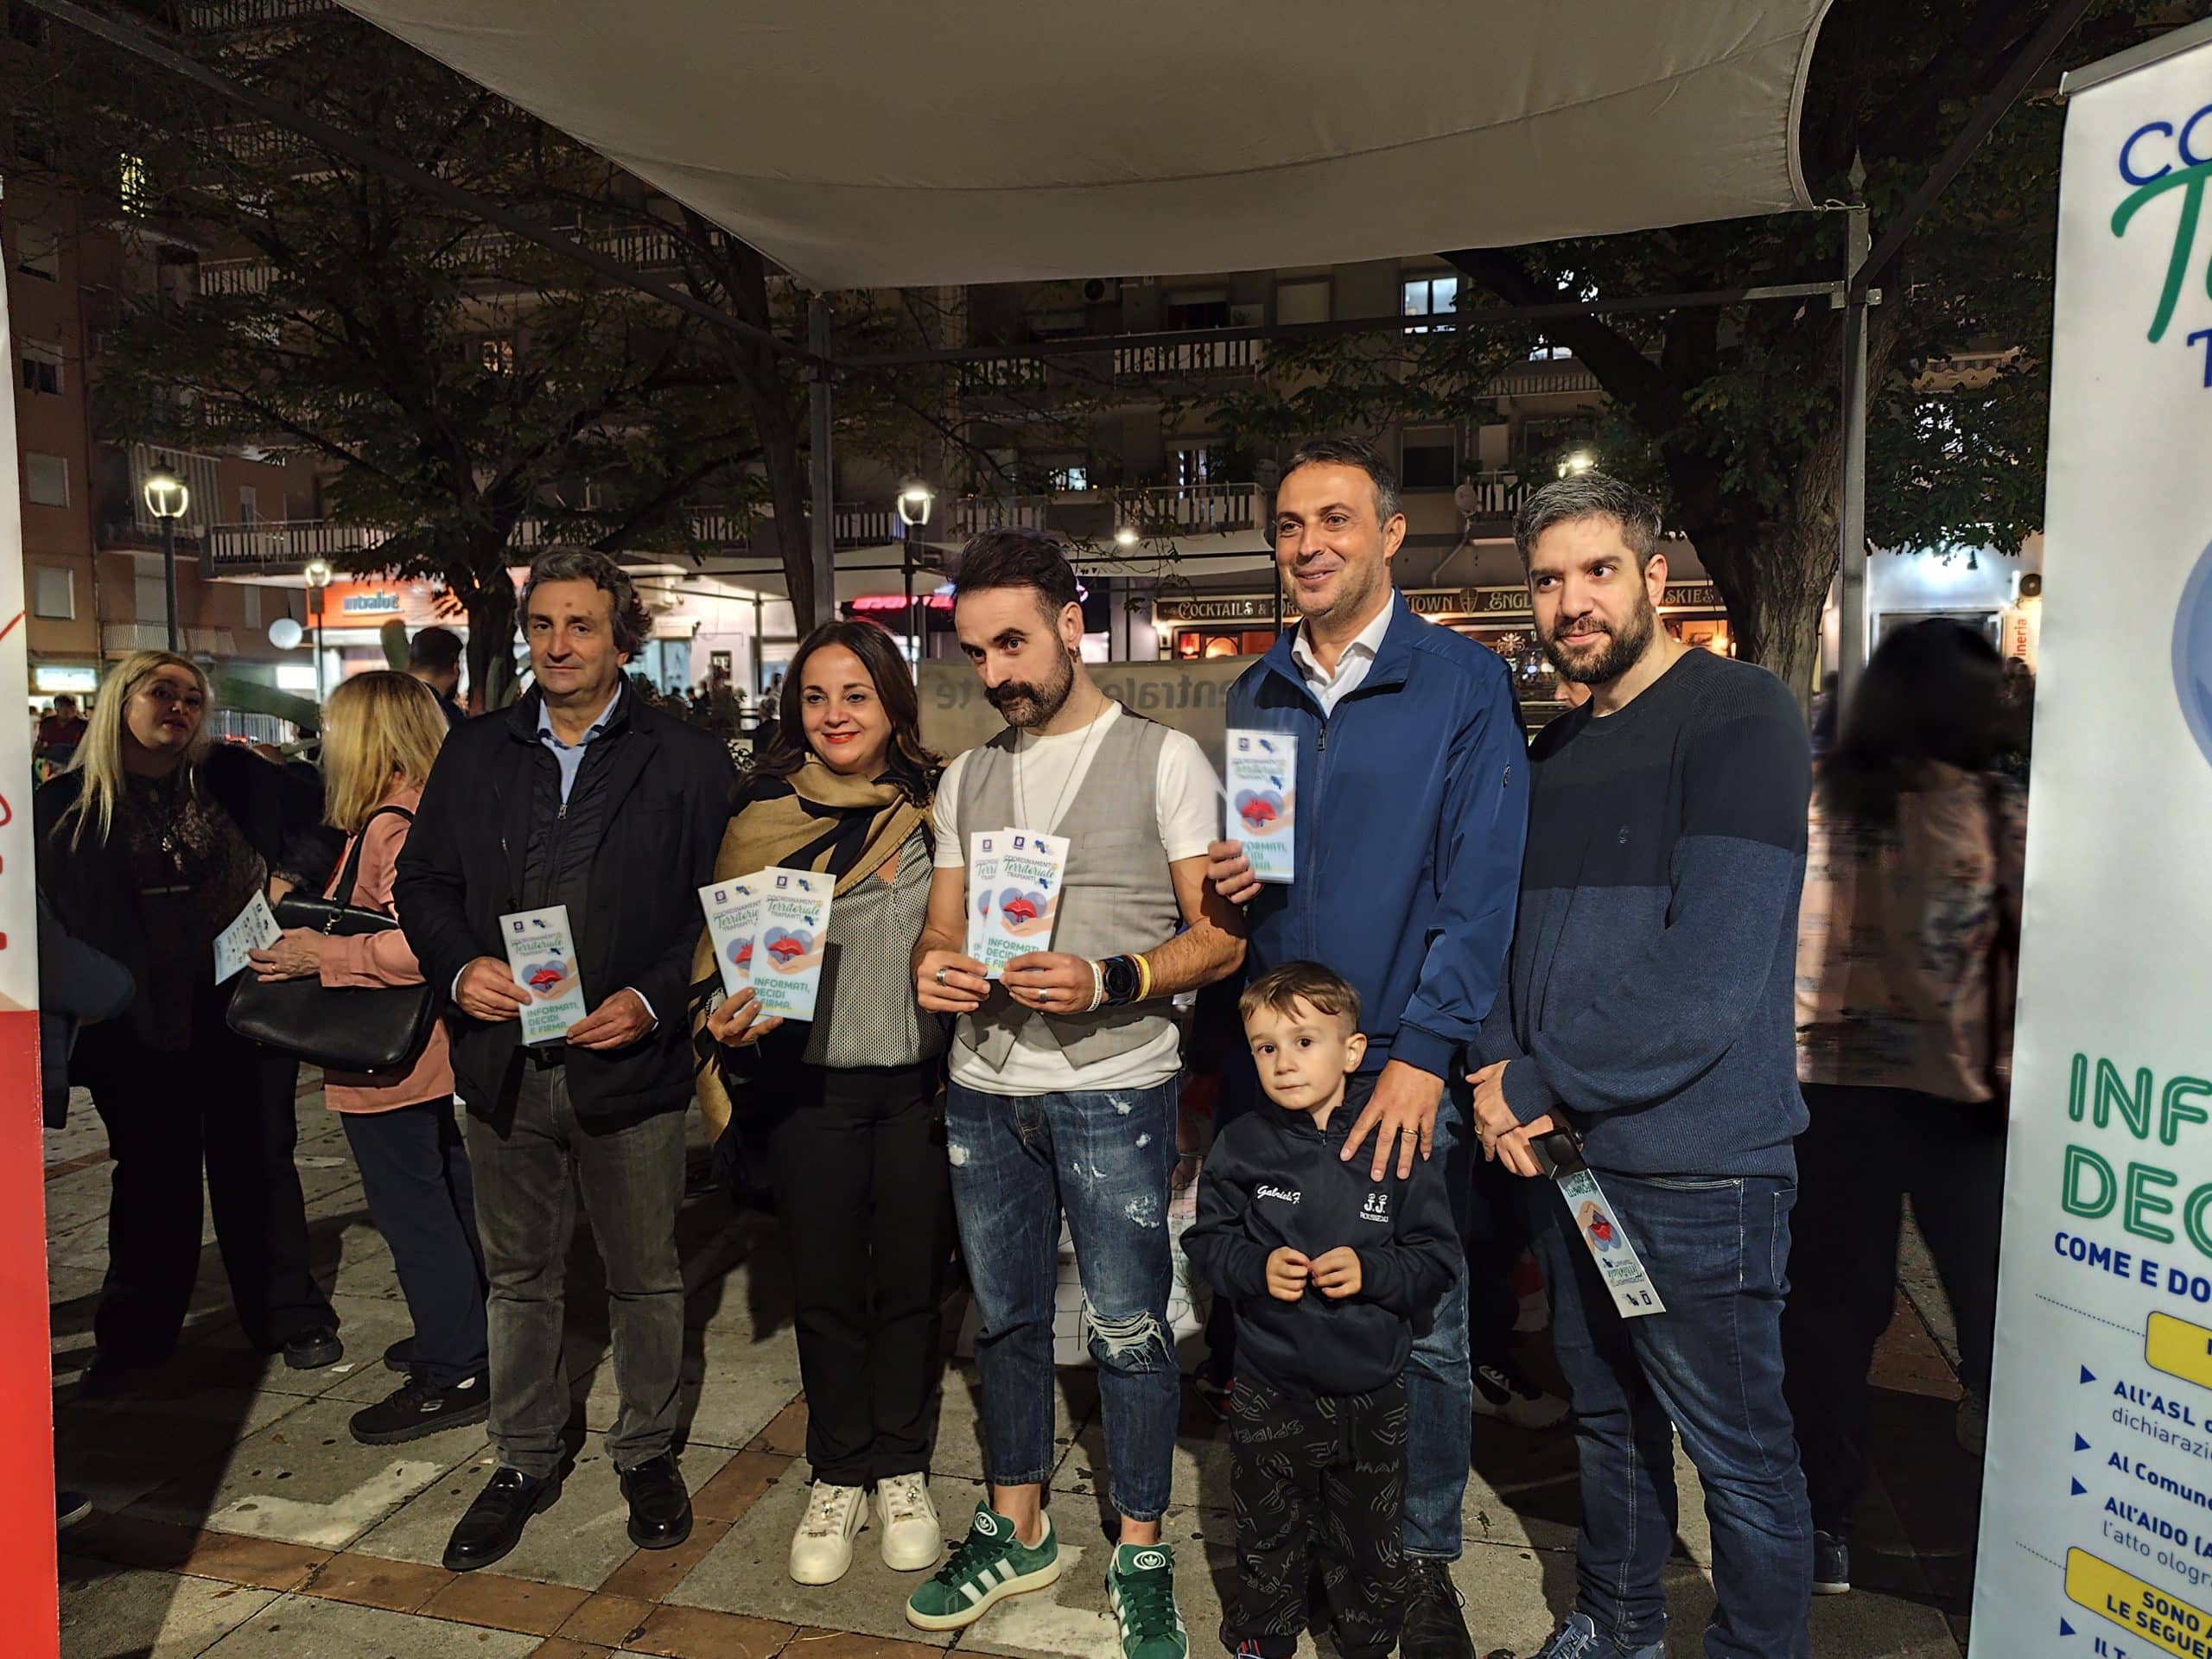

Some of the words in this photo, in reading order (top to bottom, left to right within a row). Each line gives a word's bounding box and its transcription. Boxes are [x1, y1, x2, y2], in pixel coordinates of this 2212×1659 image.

[1178, 601, 1253, 620] COCKTAILS
[1258, 603, 1267, 615] &
[2012, 618, 2026, 663] ineria
[754, 976, 810, 994] INFORMATI,
[529, 1014, 559, 1027] DECIDI
[2055, 1232, 2131, 1278] COME
[2140, 1259, 2158, 1287] E
[2168, 1268, 2211, 1303] DO
[2113, 1381, 2196, 1427] All'ASL
[2112, 1407, 2212, 1462] dichiarazi
[2108, 1452, 2129, 1473] Al
[2104, 1497, 2188, 1547] All'AIDO
[2103, 1521, 2150, 1556] l'atto
[2157, 1551, 2212, 1588] ologr
[2107, 1593, 2131, 1620] LE
[2142, 1591, 2199, 1632] SONO
